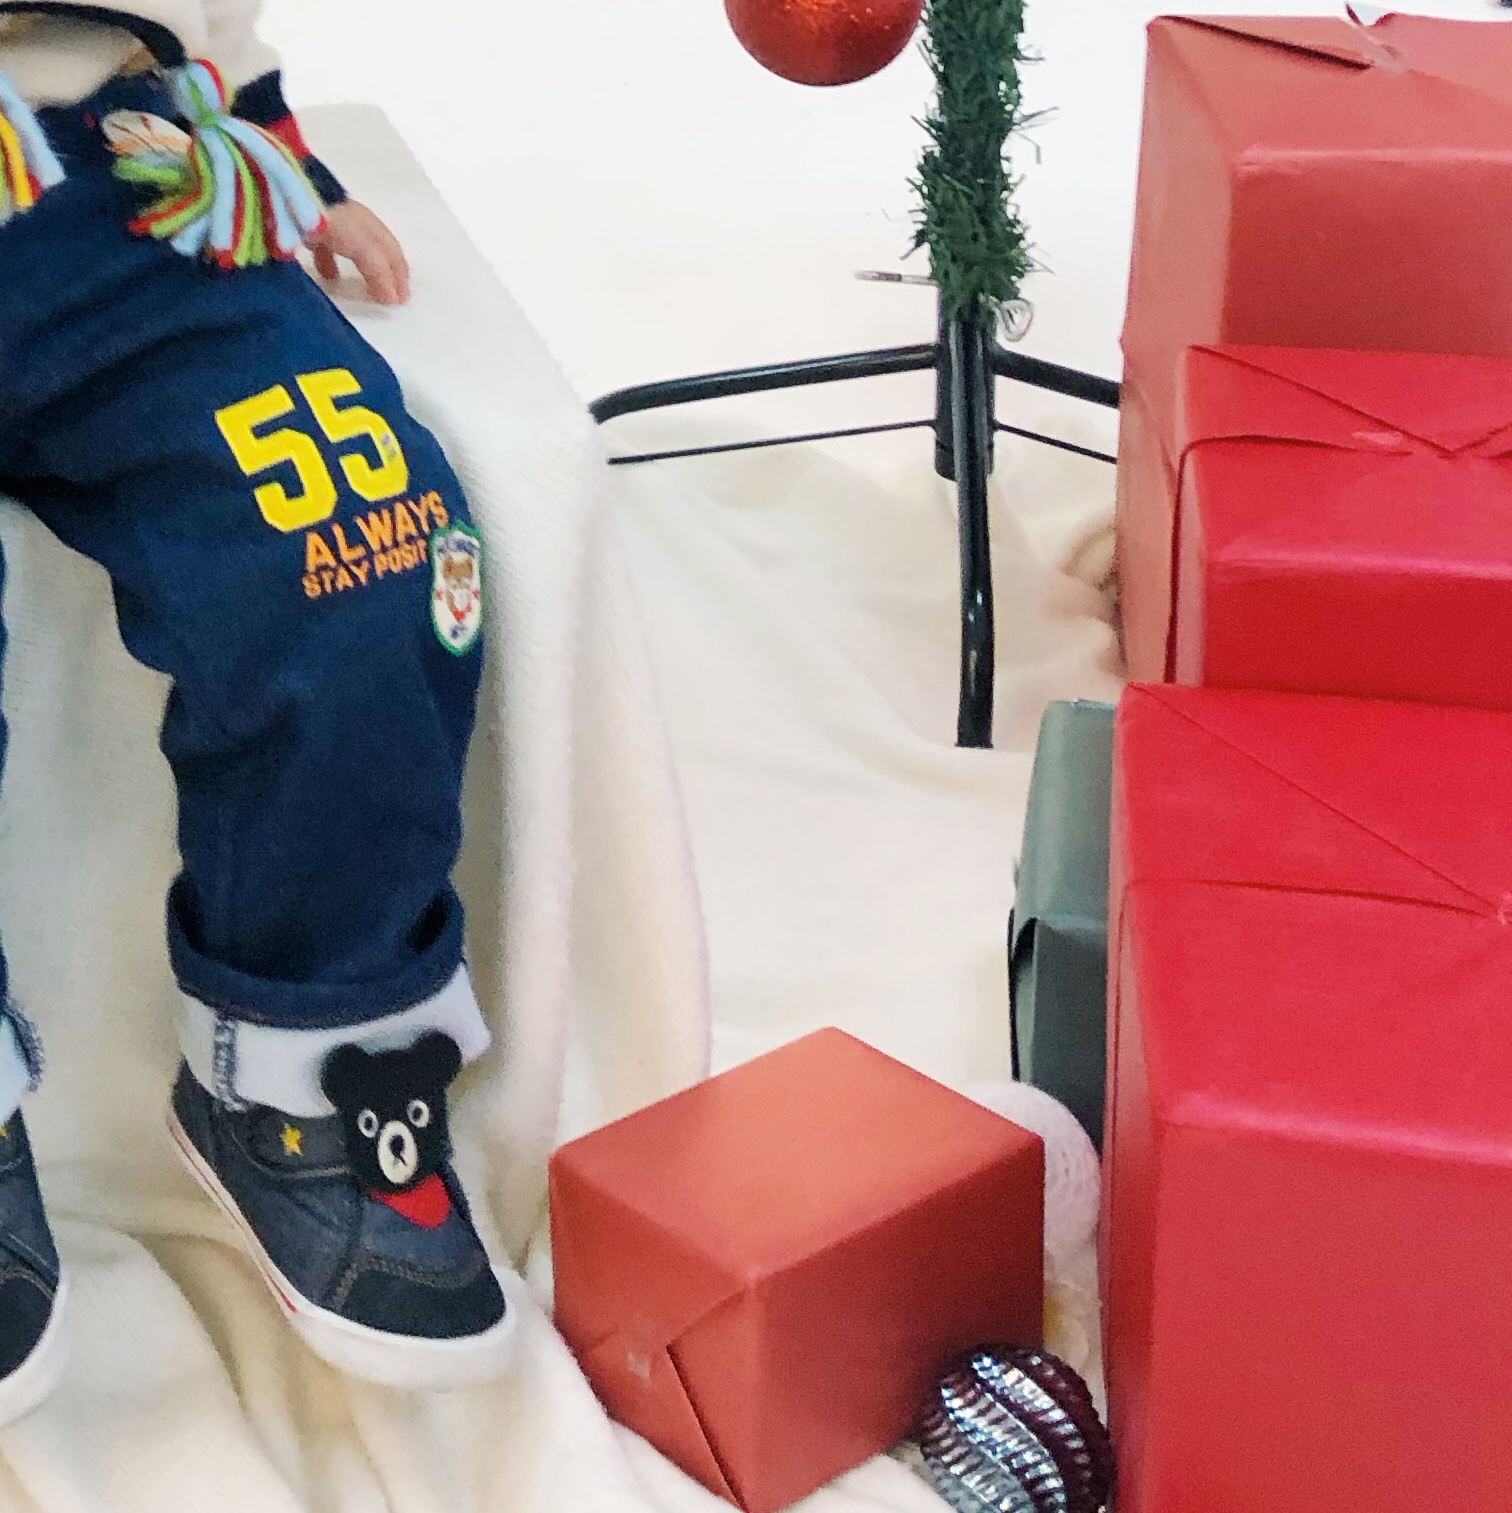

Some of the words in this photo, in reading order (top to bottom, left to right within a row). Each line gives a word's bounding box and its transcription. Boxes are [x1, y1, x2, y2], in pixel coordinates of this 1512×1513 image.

[214, 367, 409, 532] 55
[305, 490, 450, 573] ALWAYS
[301, 559, 371, 600] STAY
